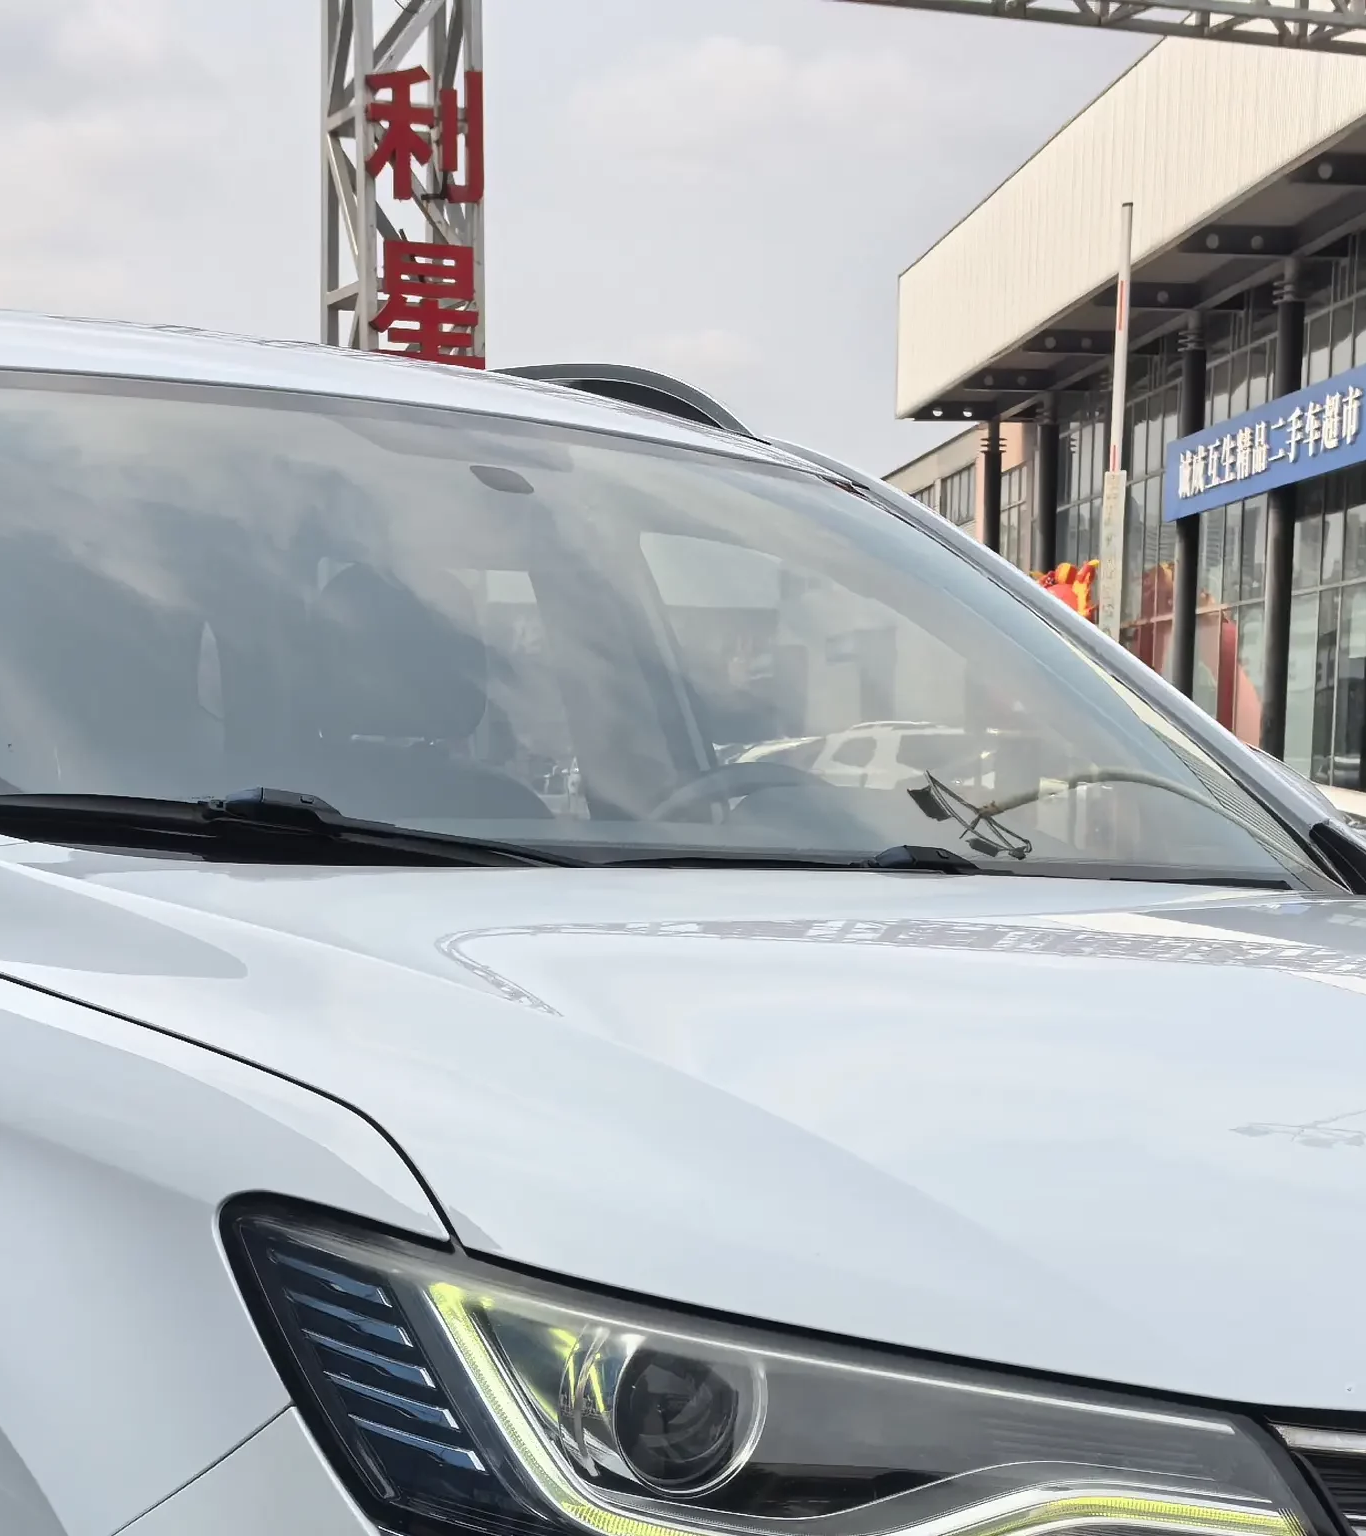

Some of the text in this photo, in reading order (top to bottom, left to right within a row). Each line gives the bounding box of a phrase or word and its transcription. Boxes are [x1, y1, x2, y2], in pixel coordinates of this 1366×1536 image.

[1178, 385, 1364, 499] 诚成互生精品二手车超市
